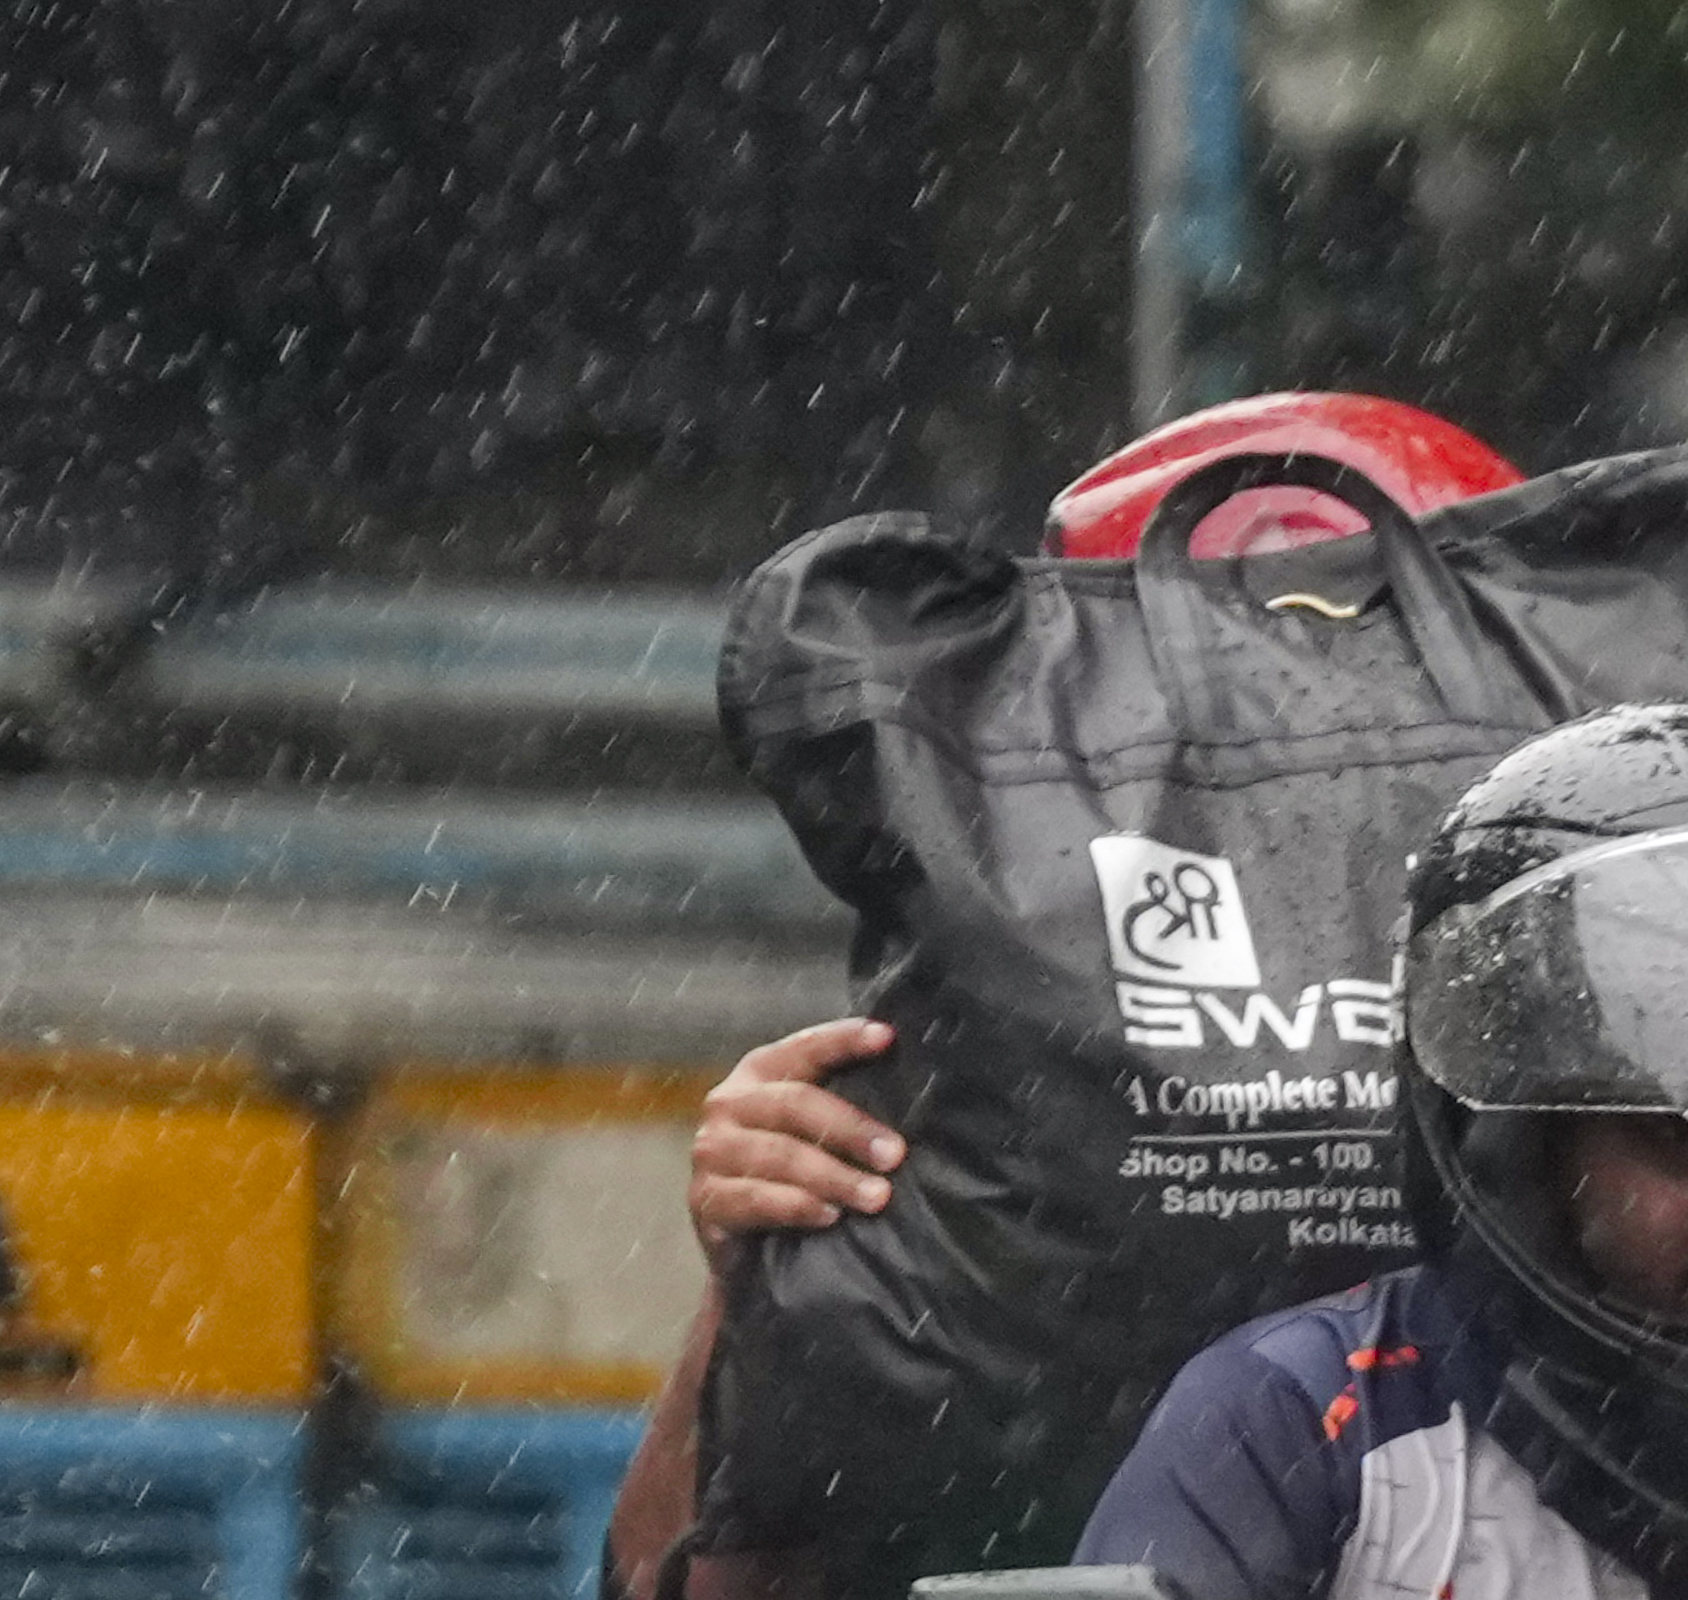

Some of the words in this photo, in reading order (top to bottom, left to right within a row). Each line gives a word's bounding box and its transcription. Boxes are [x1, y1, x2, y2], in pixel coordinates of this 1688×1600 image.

[1157, 1069, 1339, 1131] Complete
[1118, 1146, 1210, 1181] Shop
[1219, 1145, 1280, 1174] No.
